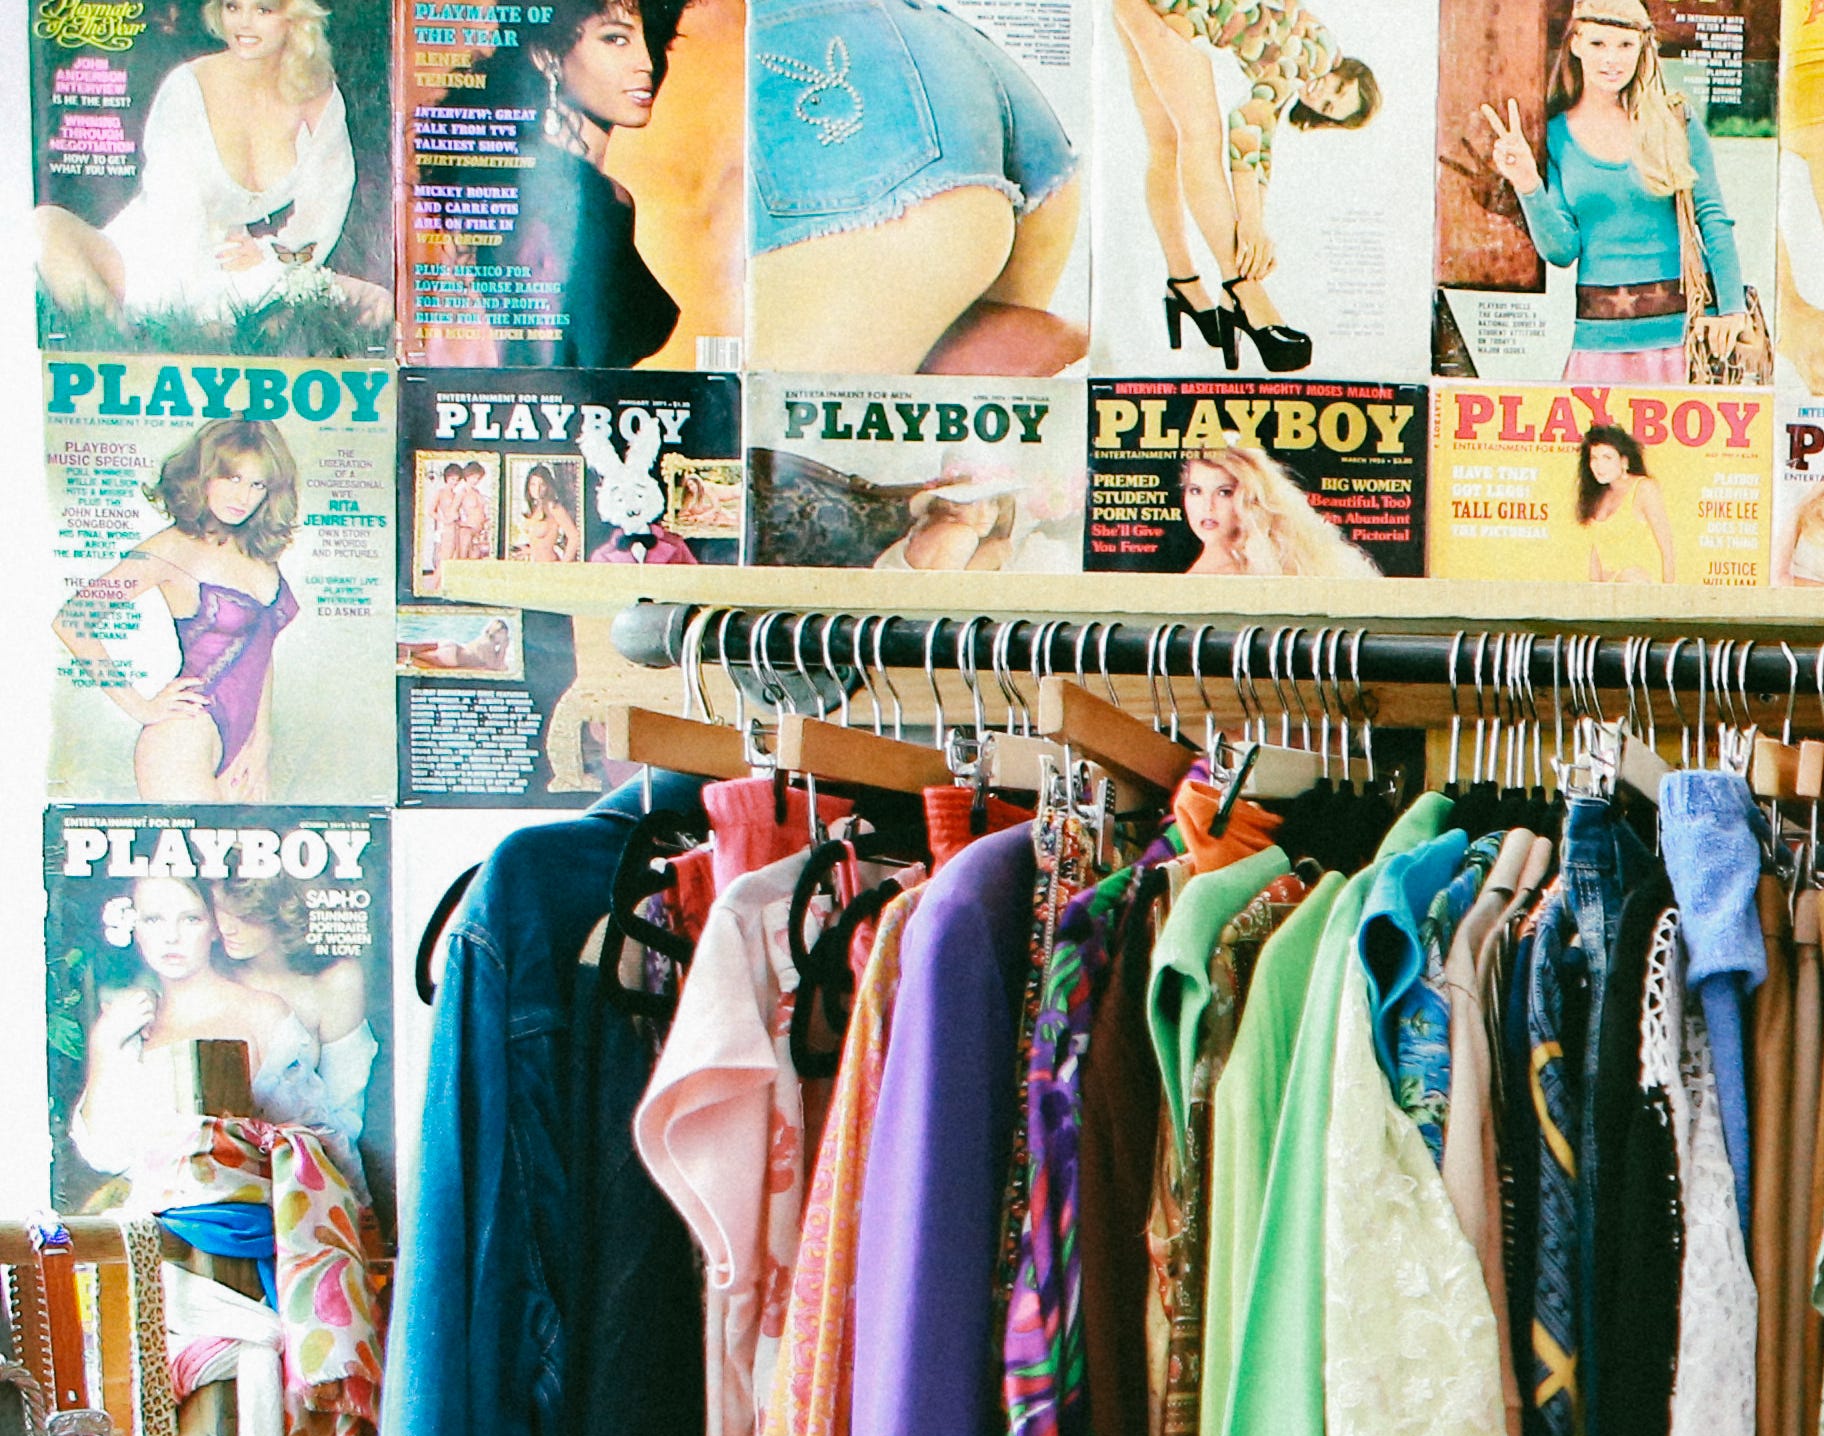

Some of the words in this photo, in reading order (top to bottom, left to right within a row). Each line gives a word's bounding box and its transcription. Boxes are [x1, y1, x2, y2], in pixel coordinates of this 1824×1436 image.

[415, 3, 521, 23] PLAYMATE
[527, 6, 553, 23] OF
[414, 28, 456, 45] THE
[463, 30, 519, 46] YEAR
[48, 363, 389, 422] PLAYBOY
[435, 403, 690, 444] PLAYBOY
[784, 402, 1050, 443] PLAYBOY
[1454, 387, 1760, 448] PLAYBOY
[1094, 400, 1413, 454] PLAYBOY
[1093, 475, 1160, 487] PREMED
[1321, 478, 1349, 491] BIG
[1352, 479, 1411, 492] WOMEN
[1093, 492, 1168, 504] STUDENT
[1093, 508, 1138, 520] PORN
[1141, 508, 1182, 520] STAR
[1346, 512, 1410, 524] Abundant
[1452, 502, 1492, 519] TALL
[1498, 502, 1548, 520] GIRLS
[1698, 502, 1733, 519] SPIKE
[1737, 503, 1758, 520] LEE
[1352, 529, 1409, 541] Pictorial
[1708, 562, 1757, 576] JUSTICE
[62, 828, 371, 879] PLAYBOY
[306, 889, 370, 909] SAPHO
[308, 910, 367, 922] STUNNING
[306, 933, 322, 944] OF
[326, 933, 371, 945] WOMEN
